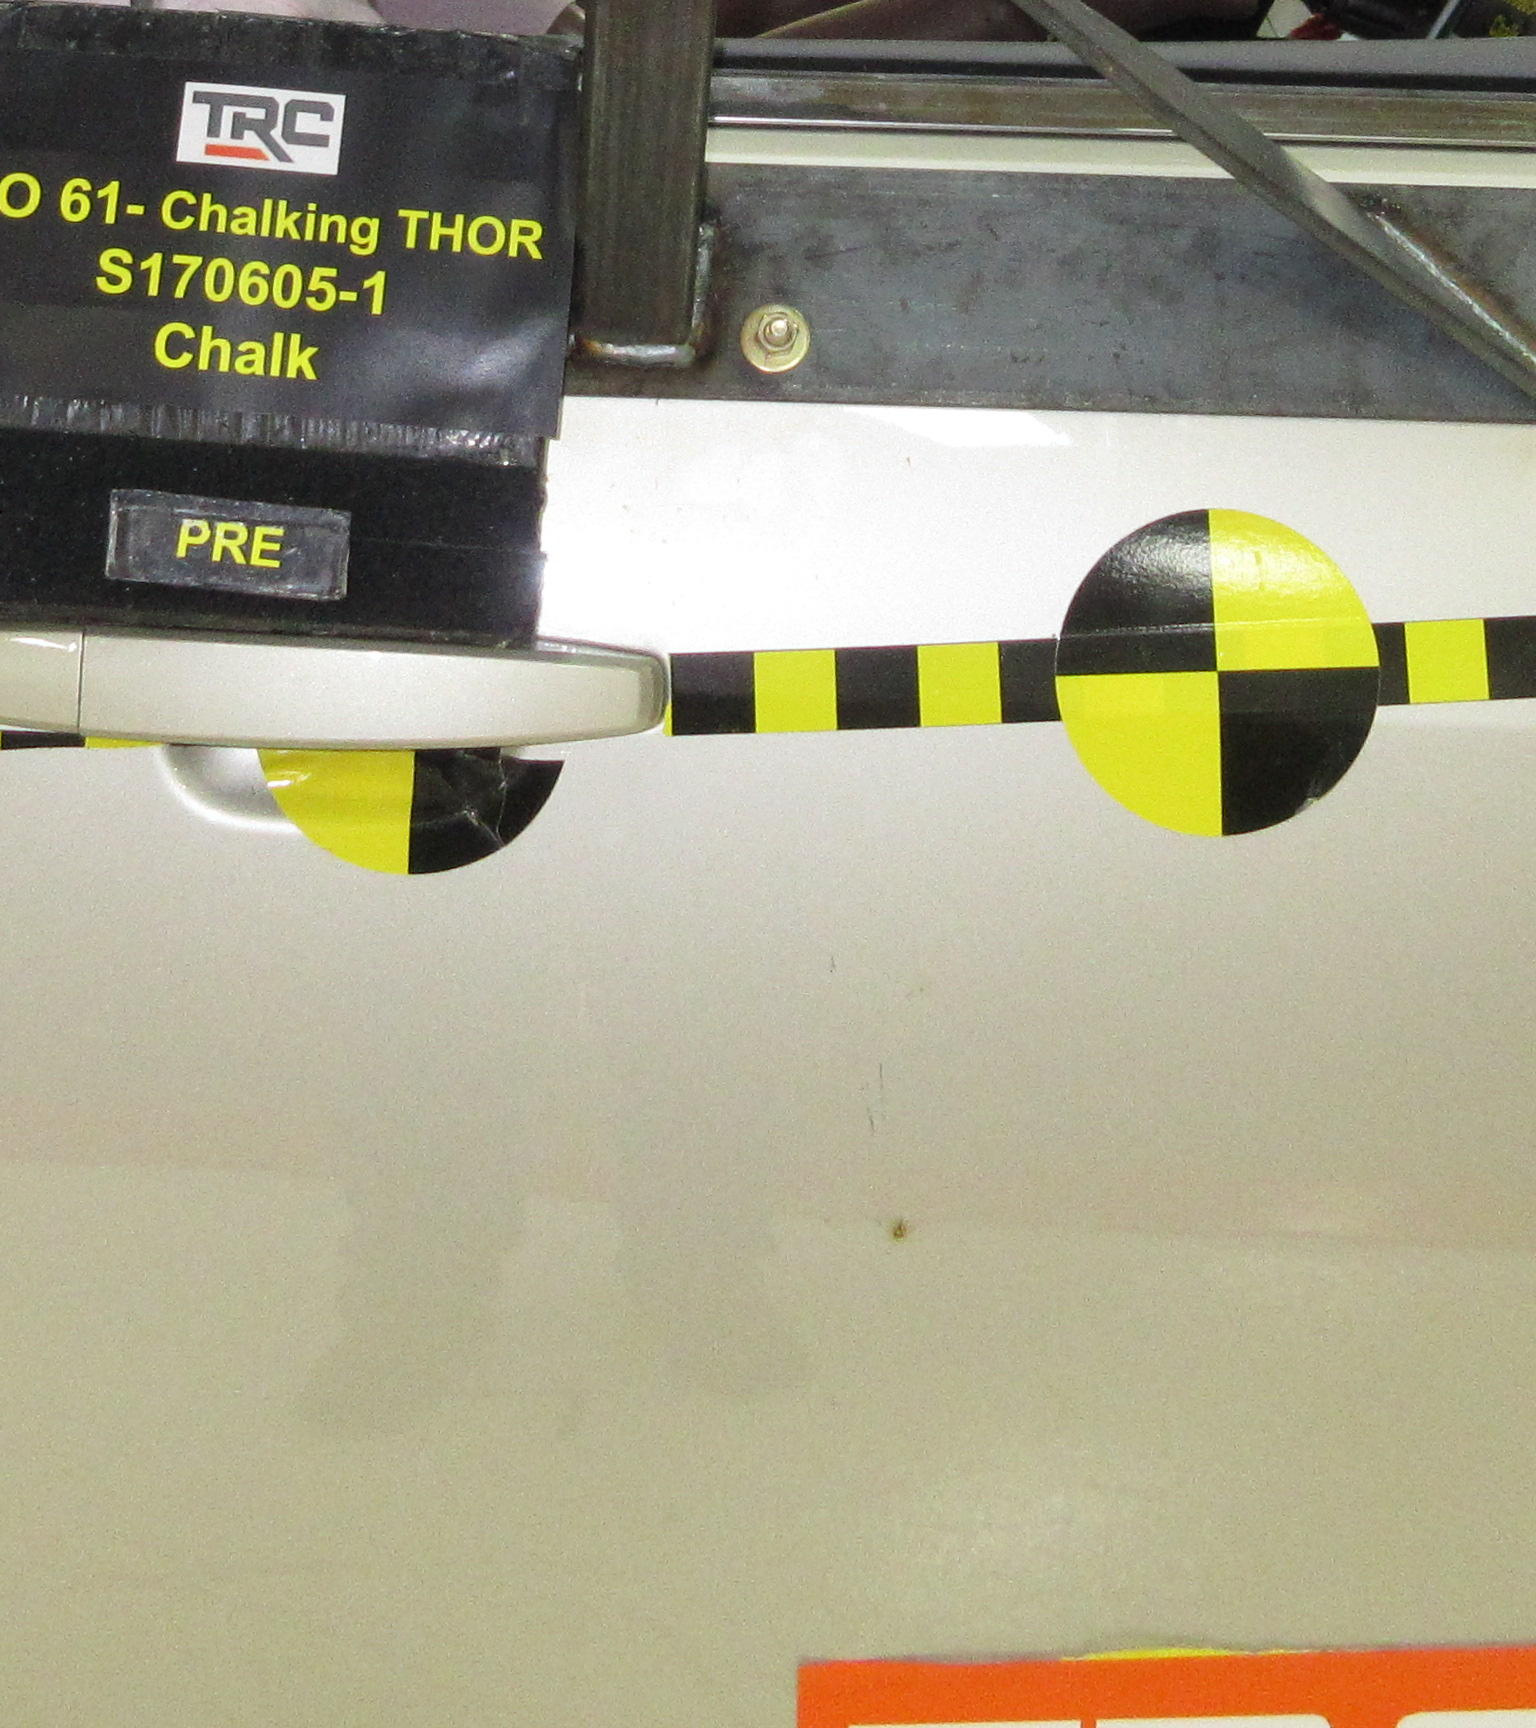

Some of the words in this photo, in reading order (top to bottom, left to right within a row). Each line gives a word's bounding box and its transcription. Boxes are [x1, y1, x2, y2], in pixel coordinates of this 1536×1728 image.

[191, 90, 336, 164] TRC
[59, 178, 146, 226] 61-
[160, 189, 381, 258] Chalking
[397, 208, 544, 262] THOR
[94, 247, 388, 317] S170605-1
[152, 322, 320, 382] Chalk
[174, 519, 285, 569] PRE
